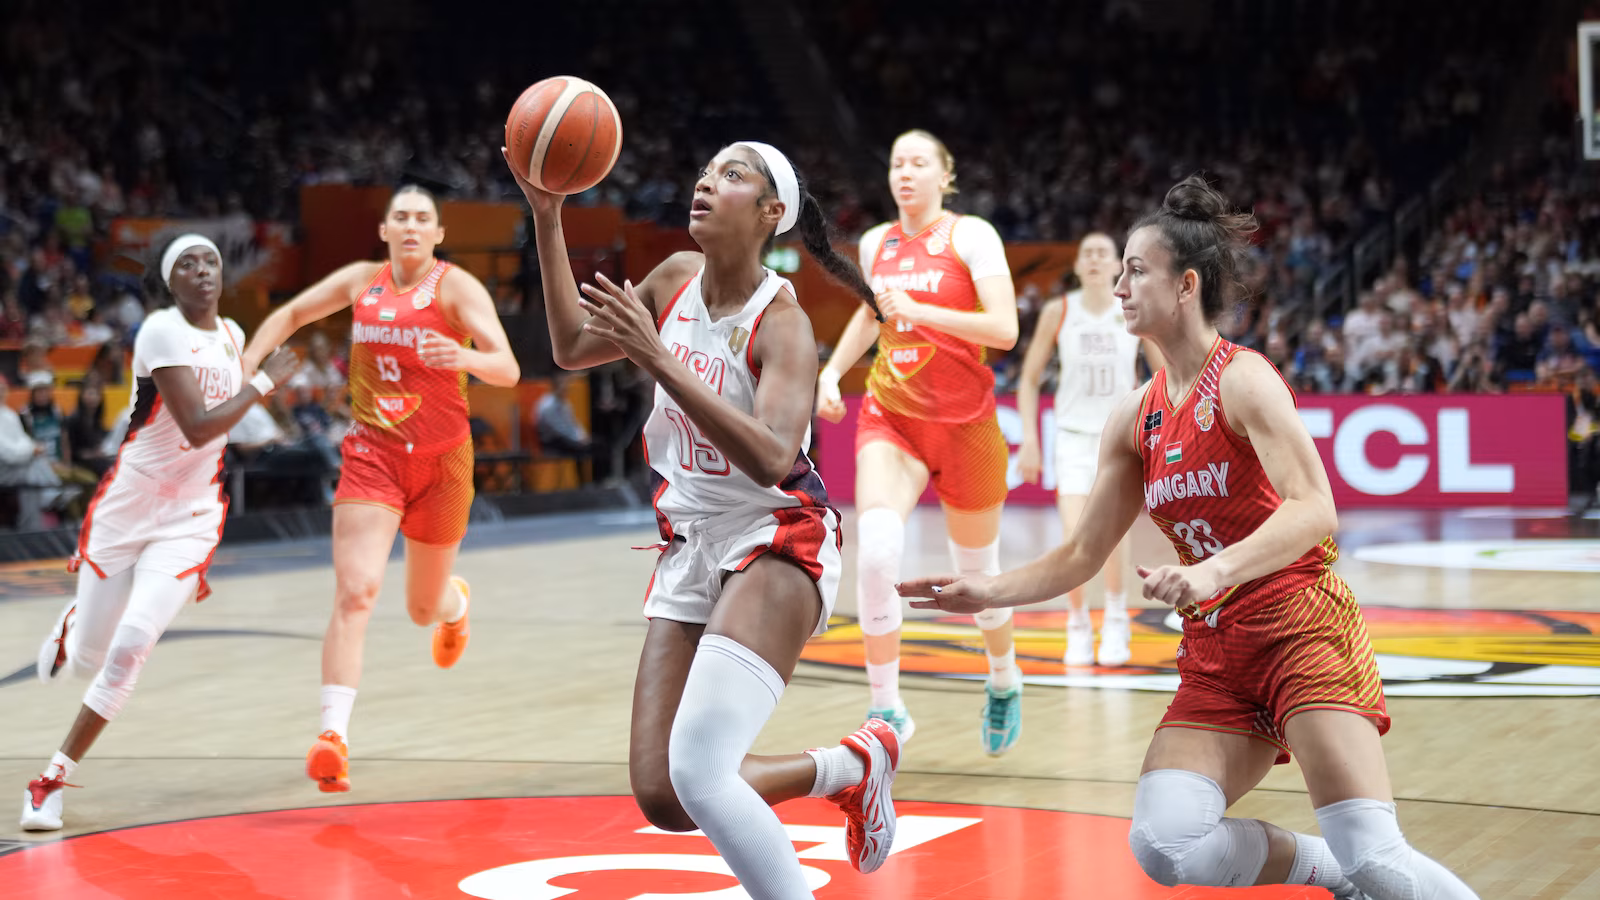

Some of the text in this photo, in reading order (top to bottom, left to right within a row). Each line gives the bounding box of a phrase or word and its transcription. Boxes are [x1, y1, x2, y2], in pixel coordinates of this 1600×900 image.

[352, 322, 428, 354] HUNGARY
[376, 355, 402, 382] 13
[664, 407, 731, 476] 15
[1144, 461, 1230, 512] HUNGARY
[1173, 518, 1225, 558] 33
